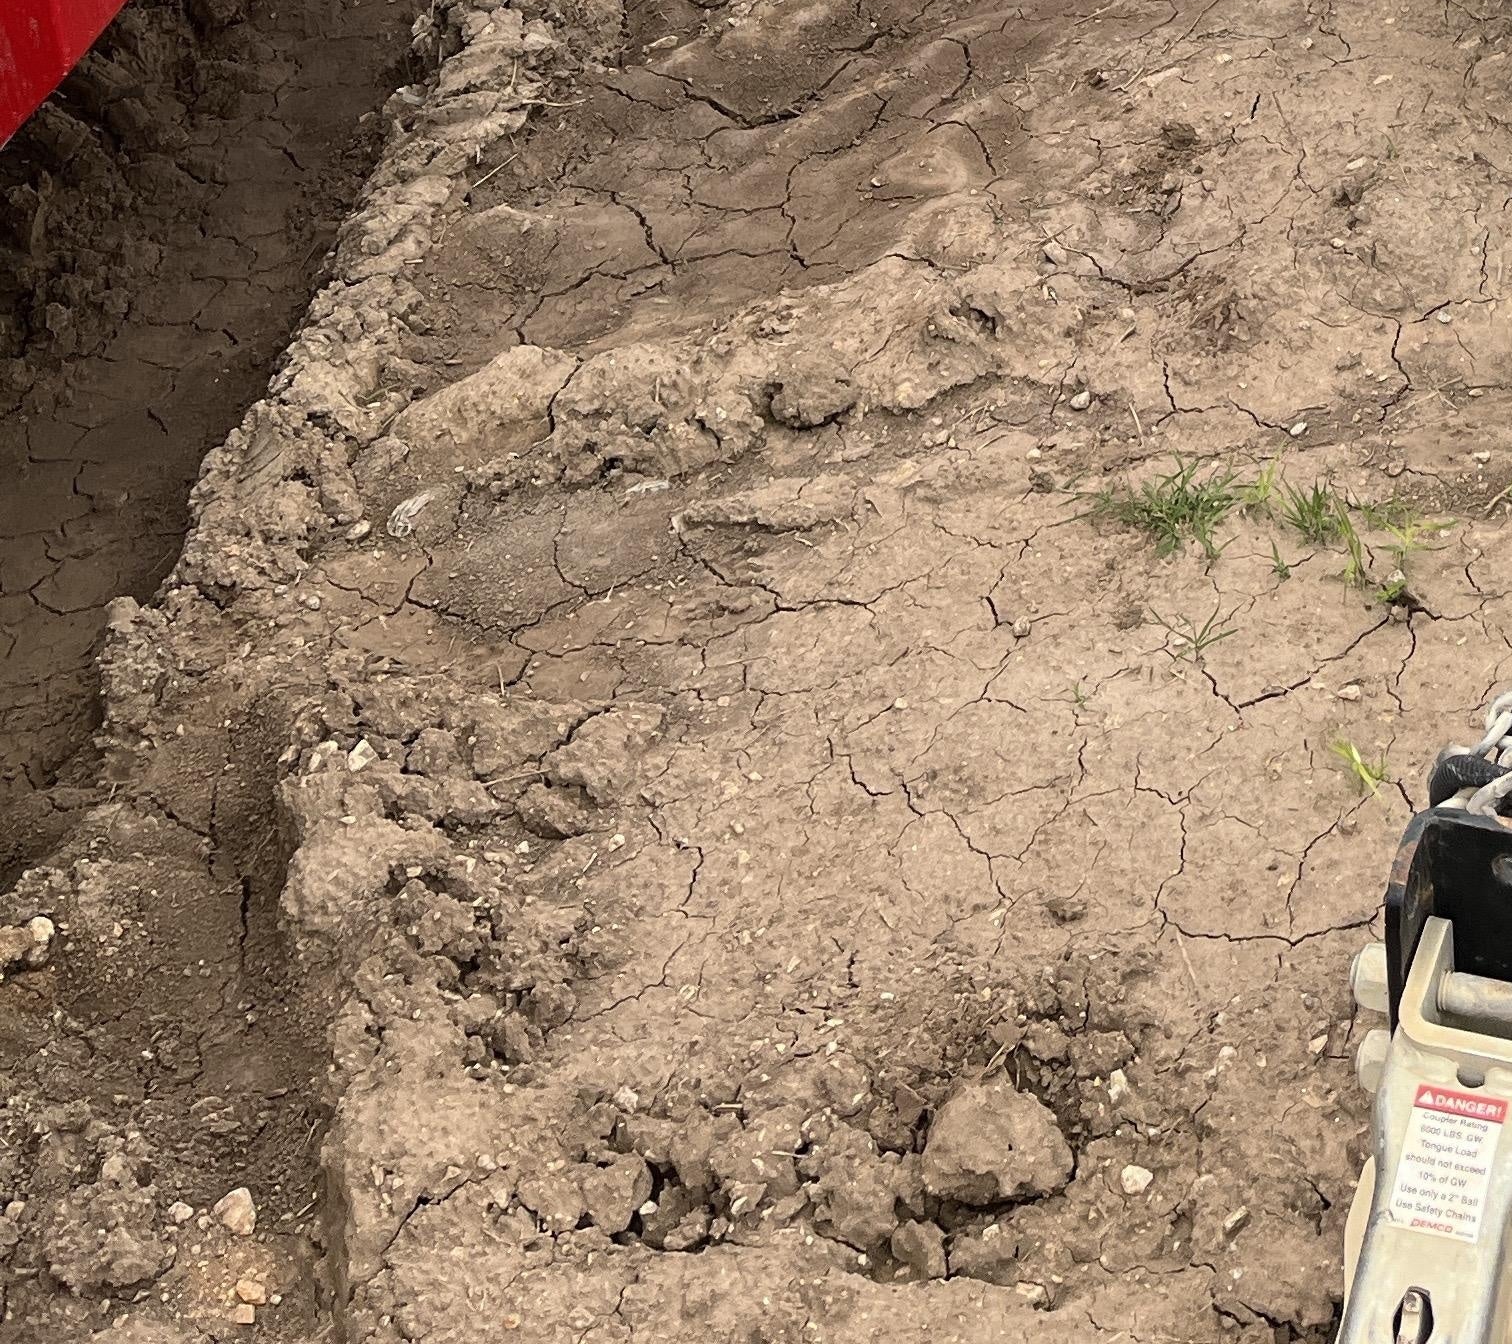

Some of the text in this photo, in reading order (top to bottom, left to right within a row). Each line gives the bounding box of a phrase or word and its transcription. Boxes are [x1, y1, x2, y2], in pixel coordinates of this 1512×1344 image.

[1434, 1094, 1503, 1118] DANGER!
[1420, 1140, 1478, 1158] Tongue Load
[1405, 1154, 1486, 1175] should not exceed
[1419, 1170, 1436, 1182] 10%
[1438, 1176, 1449, 1184] of
[1400, 1183, 1417, 1194] Use
[1419, 1189, 1439, 1200] only
[1461, 1196, 1478, 1207] Ball
[1395, 1199, 1477, 1223] Use Safety Chains
[1410, 1218, 1453, 1234] DEMCO
